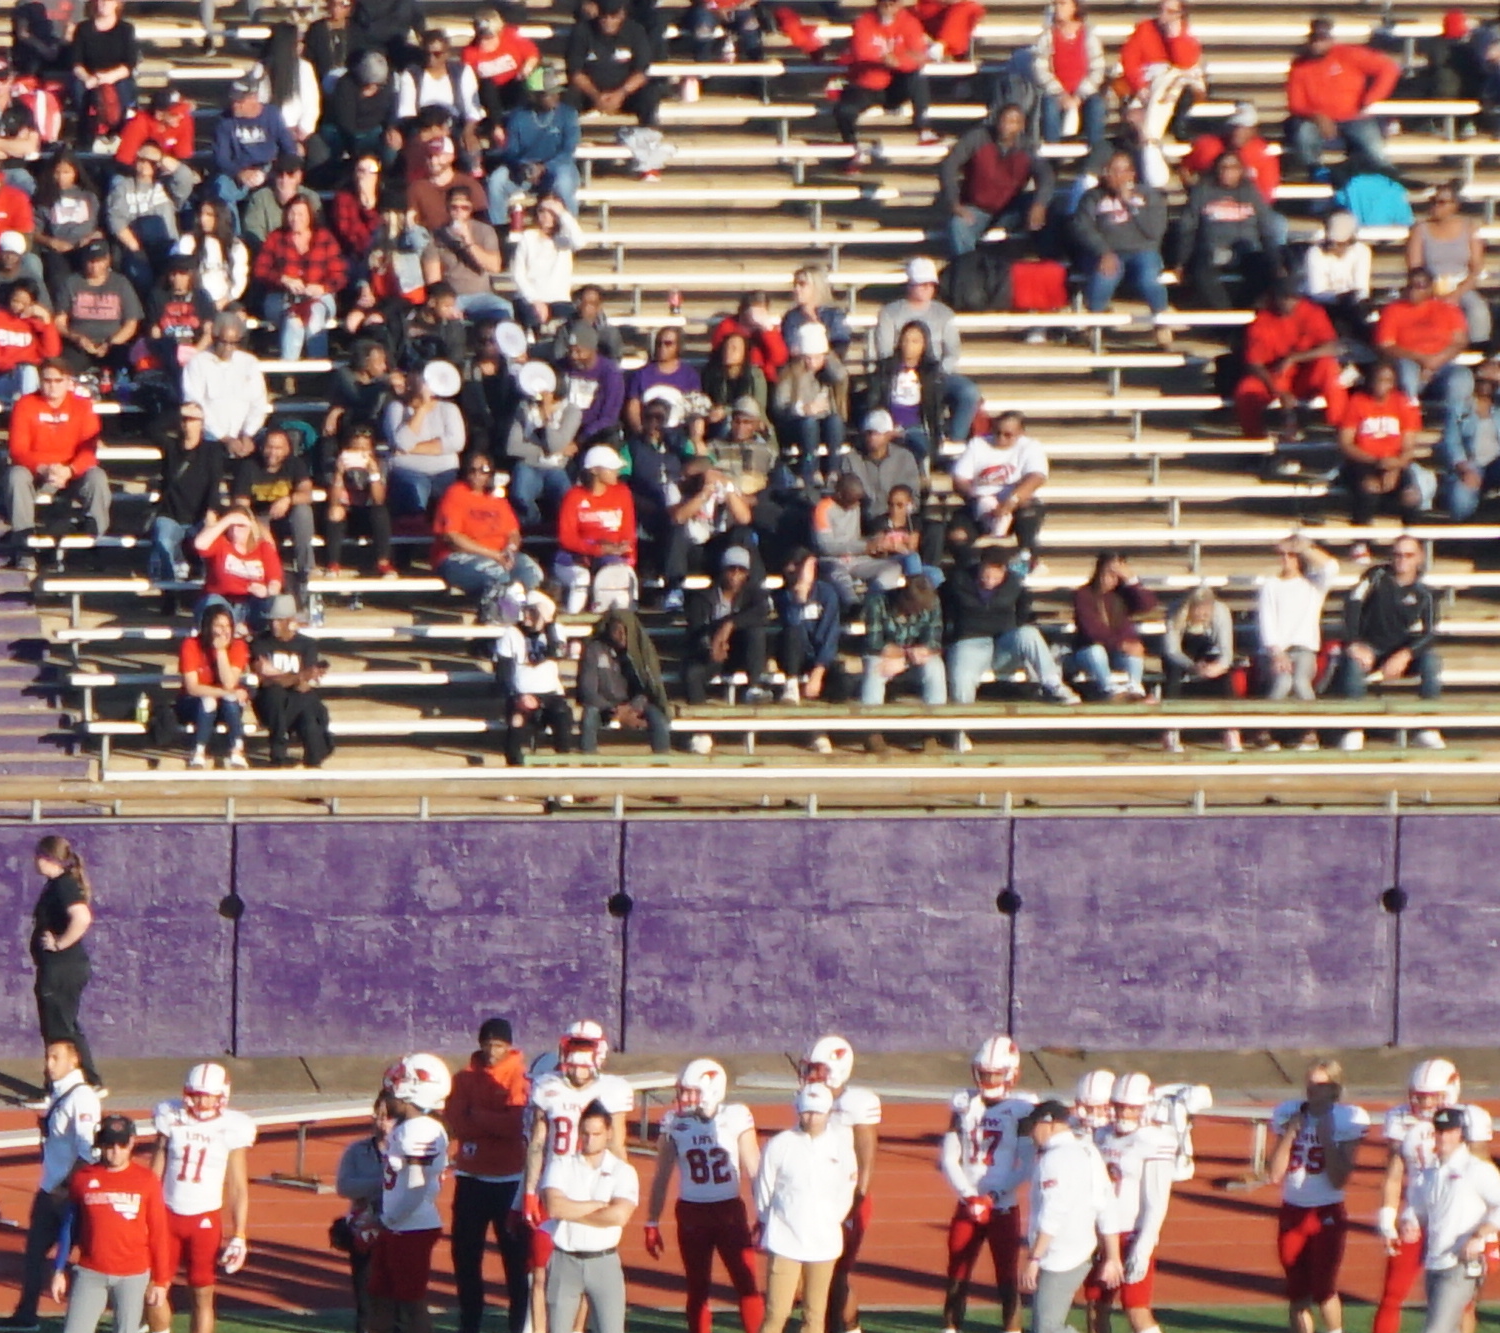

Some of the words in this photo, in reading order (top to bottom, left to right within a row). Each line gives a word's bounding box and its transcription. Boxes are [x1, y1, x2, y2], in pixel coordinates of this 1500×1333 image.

[178, 1145, 207, 1183] 11
[685, 1147, 732, 1184] 82
[970, 1130, 1003, 1167] 17
